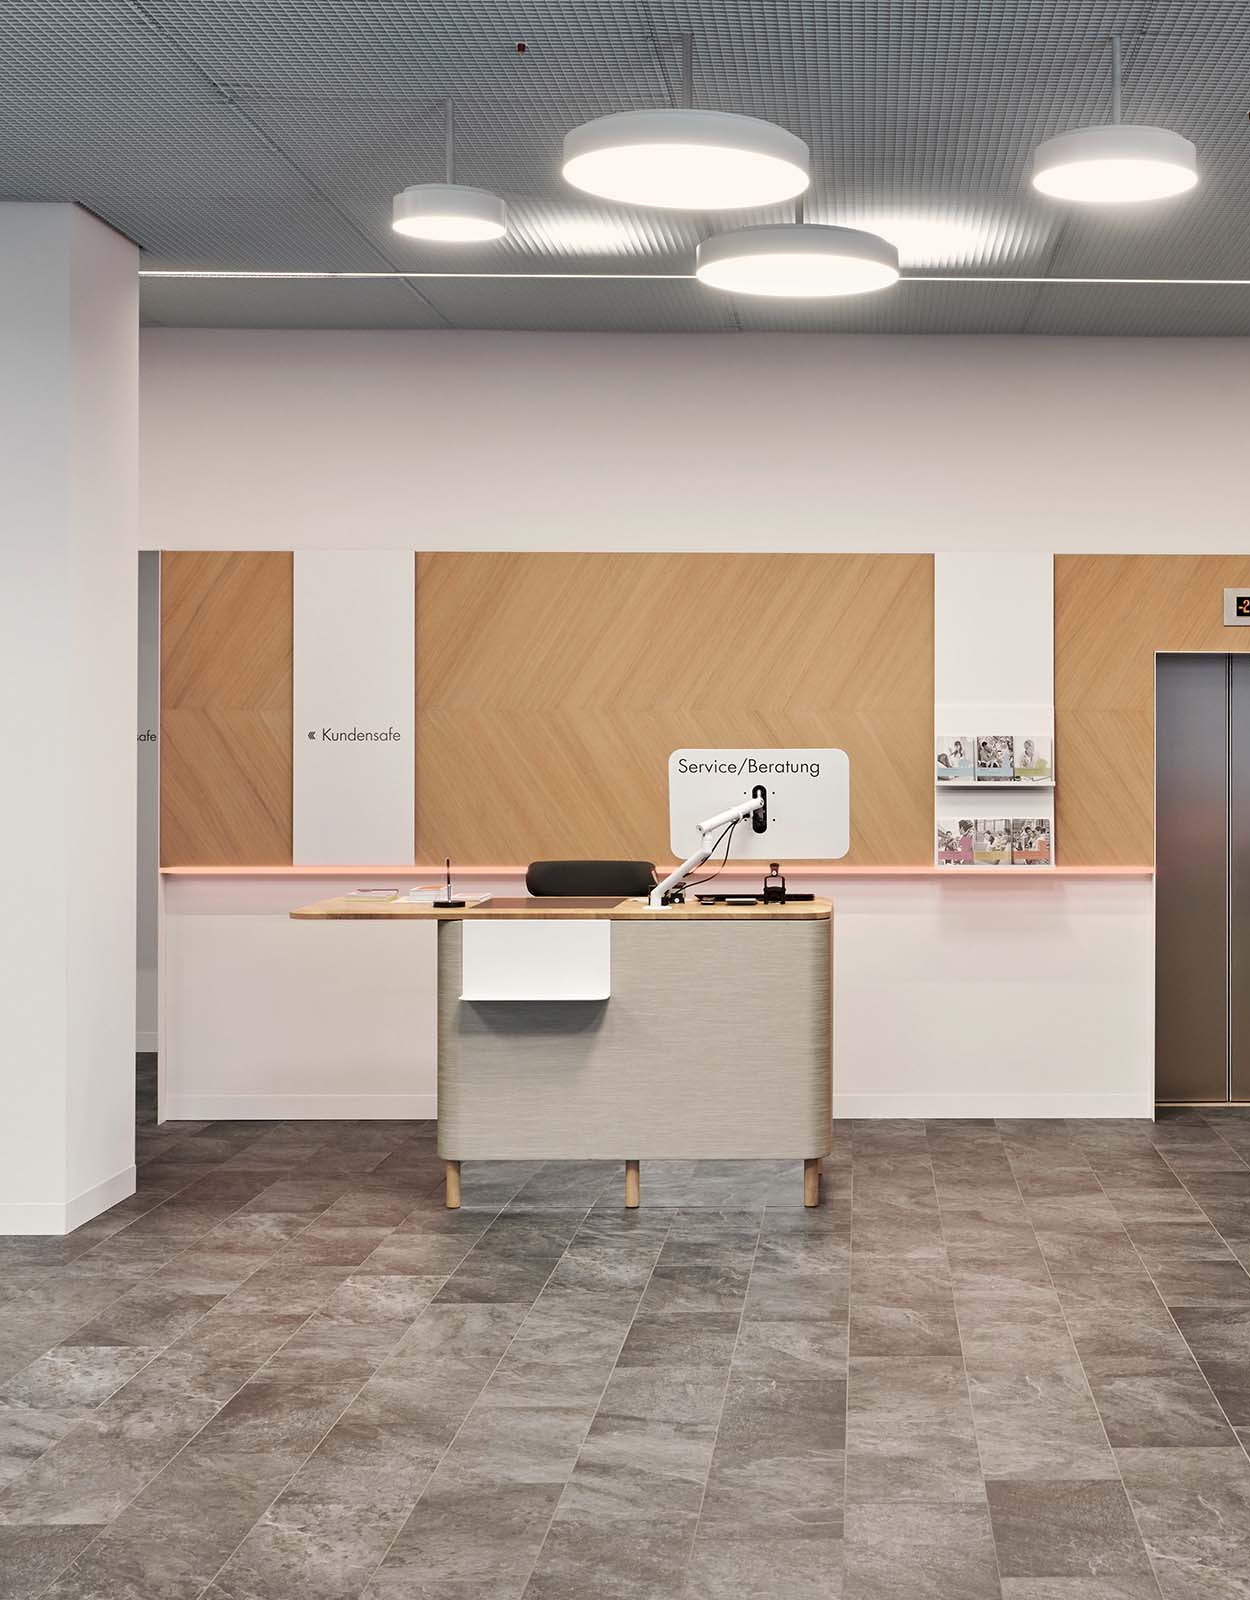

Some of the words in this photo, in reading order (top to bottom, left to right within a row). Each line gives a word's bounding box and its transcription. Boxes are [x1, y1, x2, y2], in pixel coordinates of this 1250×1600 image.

[1238, 599, 1250, 613] -2
[322, 728, 401, 742] Kundensafe
[678, 758, 820, 777] Service/Beratung
